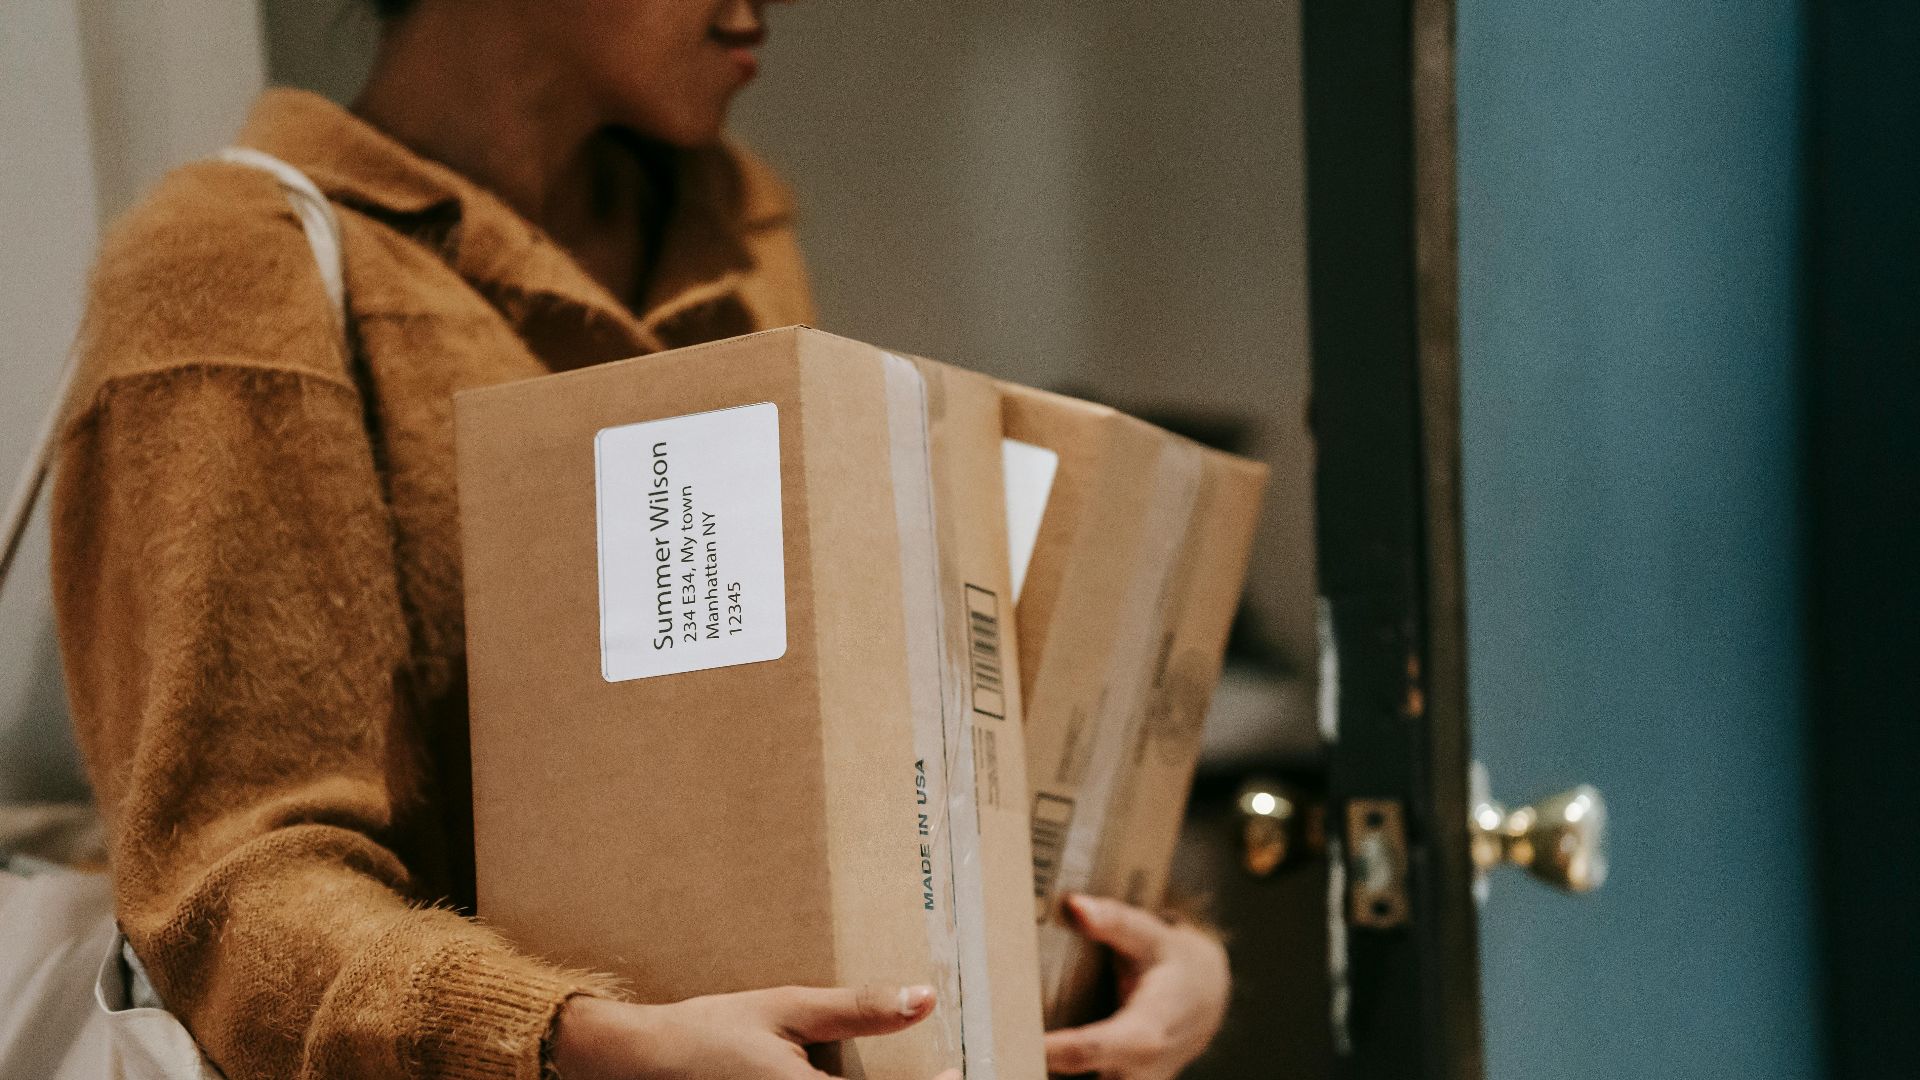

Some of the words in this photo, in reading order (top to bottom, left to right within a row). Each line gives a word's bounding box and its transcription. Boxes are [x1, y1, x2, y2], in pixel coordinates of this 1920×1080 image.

[648, 442, 670, 531] Wilson
[681, 486, 692, 530] town
[702, 512, 715, 536] NY
[681, 536, 697, 562] My
[653, 538, 674, 650] Summer
[682, 568, 696, 603] E34,
[704, 542, 719, 639] Manhattan
[683, 610, 697, 642] 234
[727, 582, 742, 636] 12345
[915, 758, 927, 805] USA
[918, 813, 928, 835] IN
[920, 844, 934, 911] MADE
